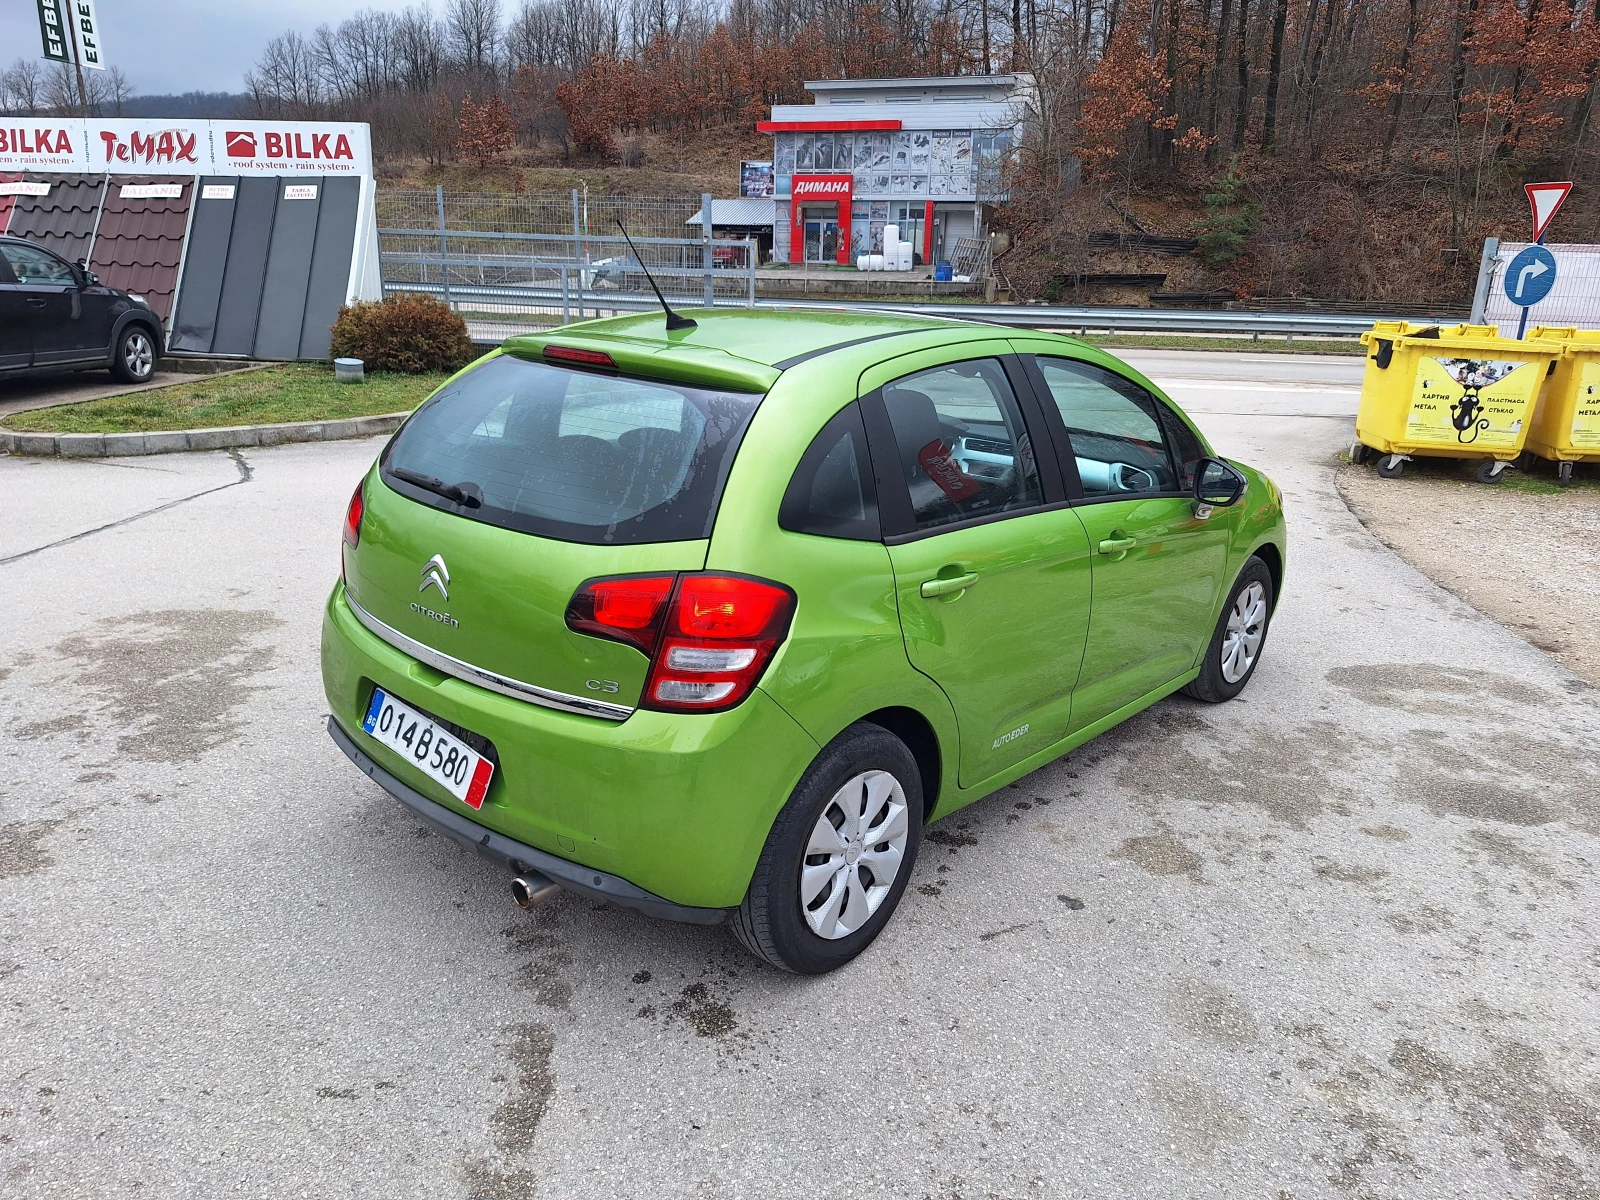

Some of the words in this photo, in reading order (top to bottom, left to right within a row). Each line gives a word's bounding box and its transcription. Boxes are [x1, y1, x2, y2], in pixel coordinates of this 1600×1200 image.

[77, 0, 99, 64] EFBE
[0, 128, 73, 154] BILKA
[99, 130, 199, 165] TeMAX
[264, 132, 354, 160] BILKA
[20, 155, 38, 164] rain
[39, 156, 70, 166] system
[233, 160, 254, 169] roof
[255, 161, 288, 170] system
[295, 161, 315, 170] rain
[317, 163, 350, 171] system
[0, 185, 47, 193] OMANIC
[121, 186, 181, 196] BALCANIC
[794, 181, 849, 194] ДИМАНА
[1421, 393, 1450, 401] ХАРТИЯ
[1413, 403, 1437, 411] МЕТАЛ
[410, 602, 460, 629] CITROËN
[585, 679, 620, 693] C3
[367, 715, 377, 727] BG
[991, 733, 1010, 750] AUTO
[1010, 723, 1029, 740] EDER
[379, 704, 469, 786] 014B580
